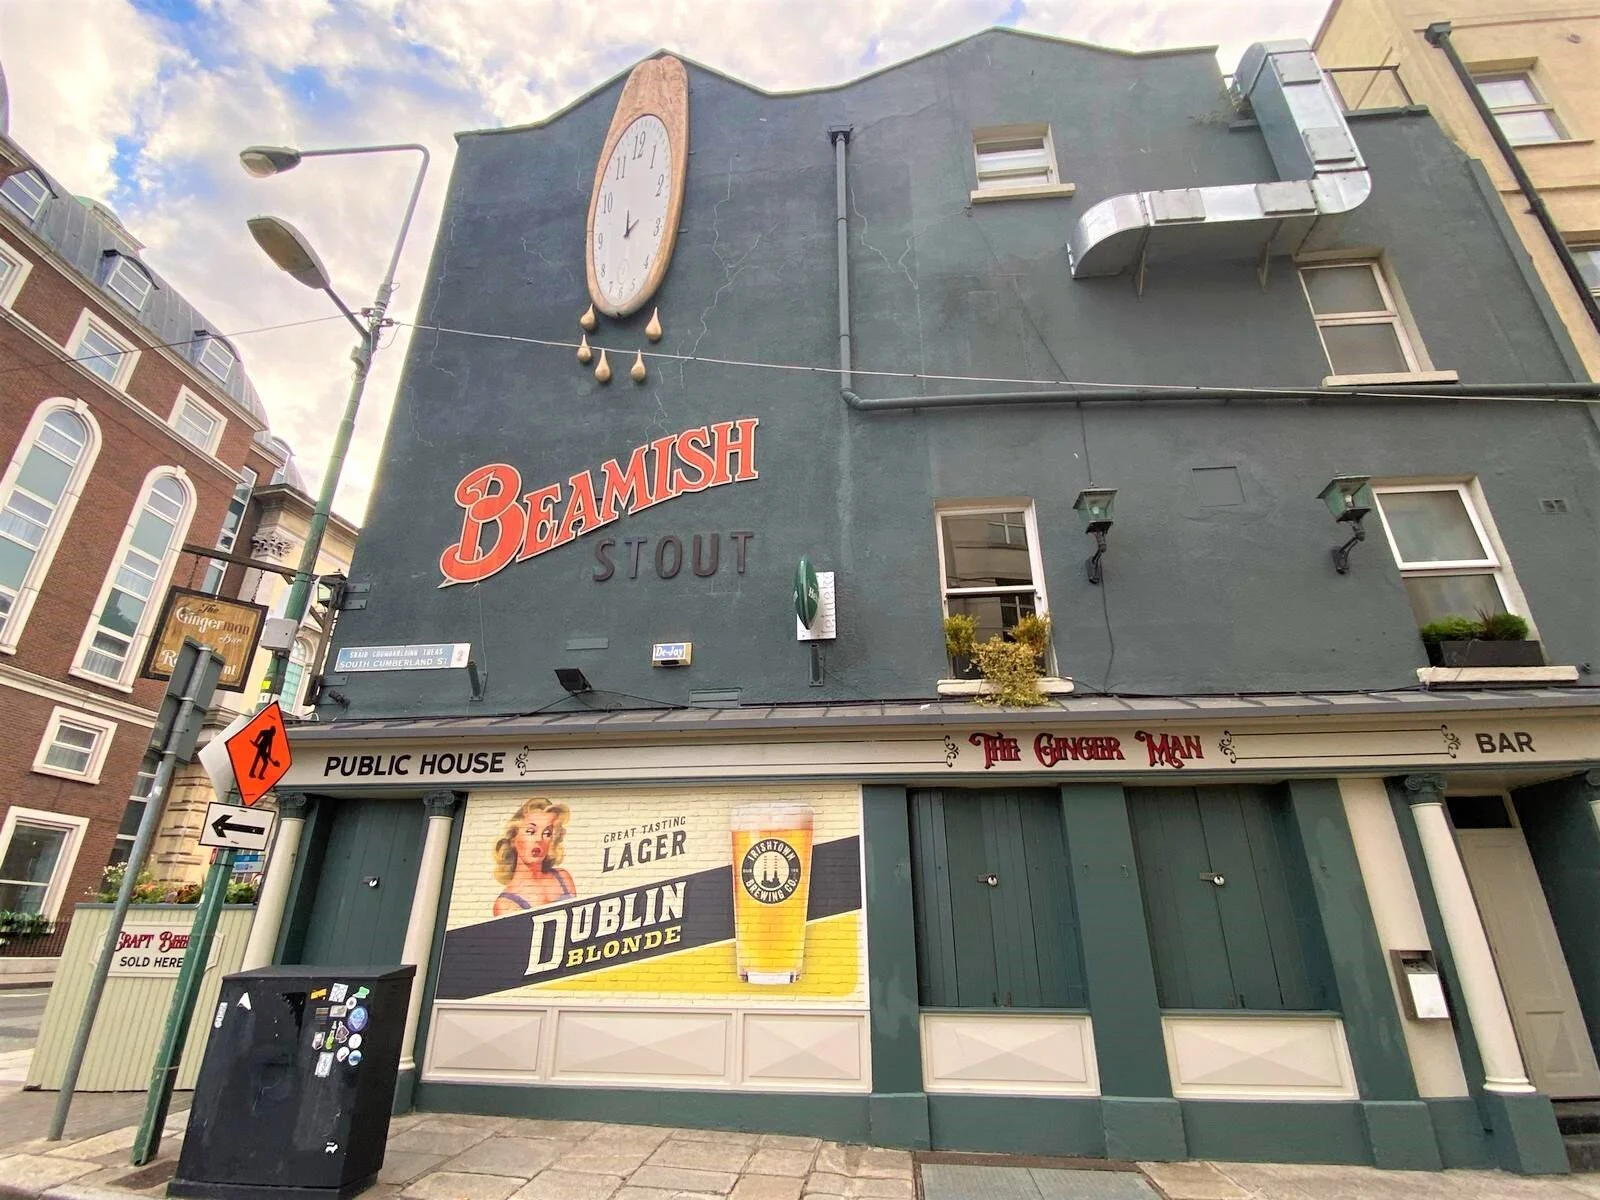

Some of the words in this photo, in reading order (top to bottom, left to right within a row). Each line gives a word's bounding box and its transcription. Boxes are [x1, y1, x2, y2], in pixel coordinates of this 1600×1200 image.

[632, 131, 646, 160] 12
[649, 144, 657, 169] 1
[615, 154, 627, 181] 11
[655, 173, 665, 198] 2
[603, 191, 614, 214] 10
[653, 217, 661, 237] 3
[598, 232, 604, 250] 9
[644, 254, 650, 270] 4
[437, 418, 759, 589] BEAMISH
[592, 531, 754, 582] STOUT
[198, 602, 219, 615] The
[340, 660, 370, 668] SOUTH
[373, 658, 433, 667] CUMBERLAND
[436, 657, 448, 665] ST
[968, 731, 1022, 770] THE
[1033, 732, 1127, 768] GINGER
[1134, 730, 1205, 769] MAN
[1475, 731, 1537, 754] BAR
[324, 755, 411, 777] PUBLIC
[419, 752, 506, 775] HOUSE
[603, 827, 638, 844] GREAT
[641, 816, 687, 835] TASTING
[601, 830, 687, 873] LAGER
[747, 840, 796, 861] IRISHTOWN
[745, 879, 786, 902] BREWING
[523, 881, 687, 976] DUBLIN
[565, 925, 682, 967] BLONDE
[120, 956, 150, 967] SOLD
[153, 957, 184, 968] HERE
